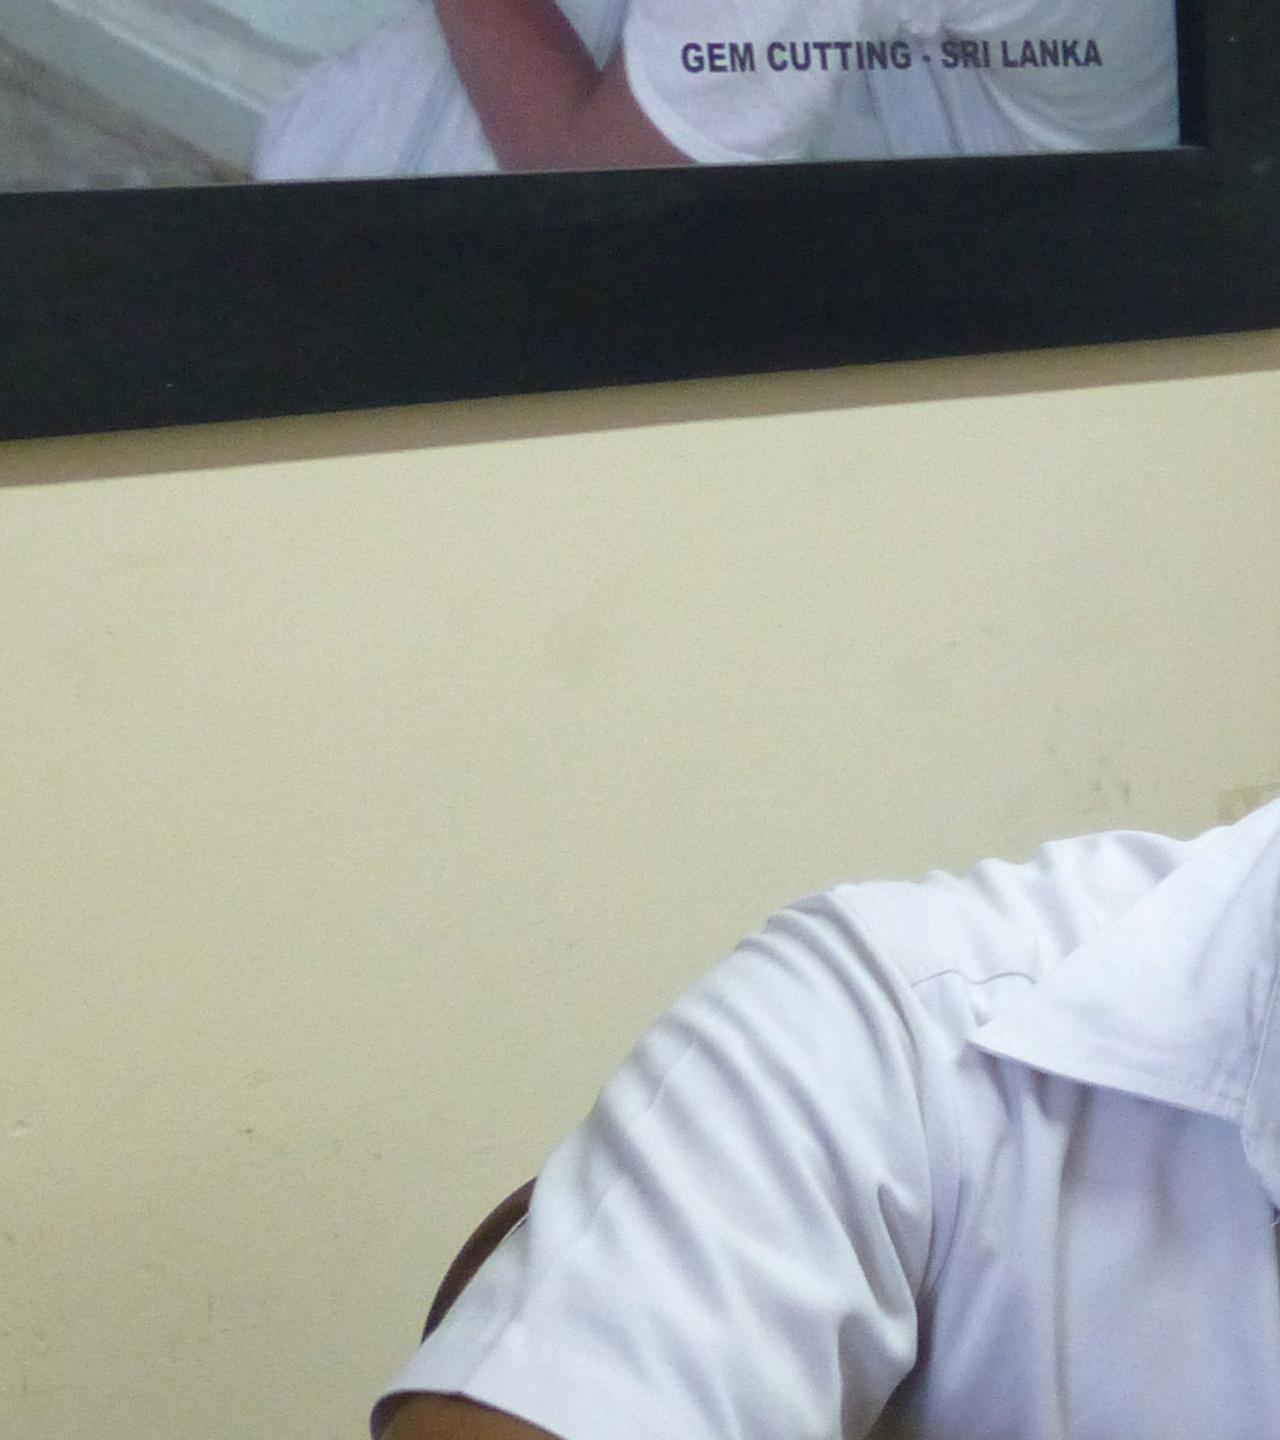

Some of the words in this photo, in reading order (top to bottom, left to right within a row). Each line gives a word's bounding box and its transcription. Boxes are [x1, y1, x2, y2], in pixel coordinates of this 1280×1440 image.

[682, 42, 756, 73] GEM
[767, 40, 912, 72] CUTTING
[941, 39, 991, 68] SRI
[1002, 38, 1104, 68] LANKA
